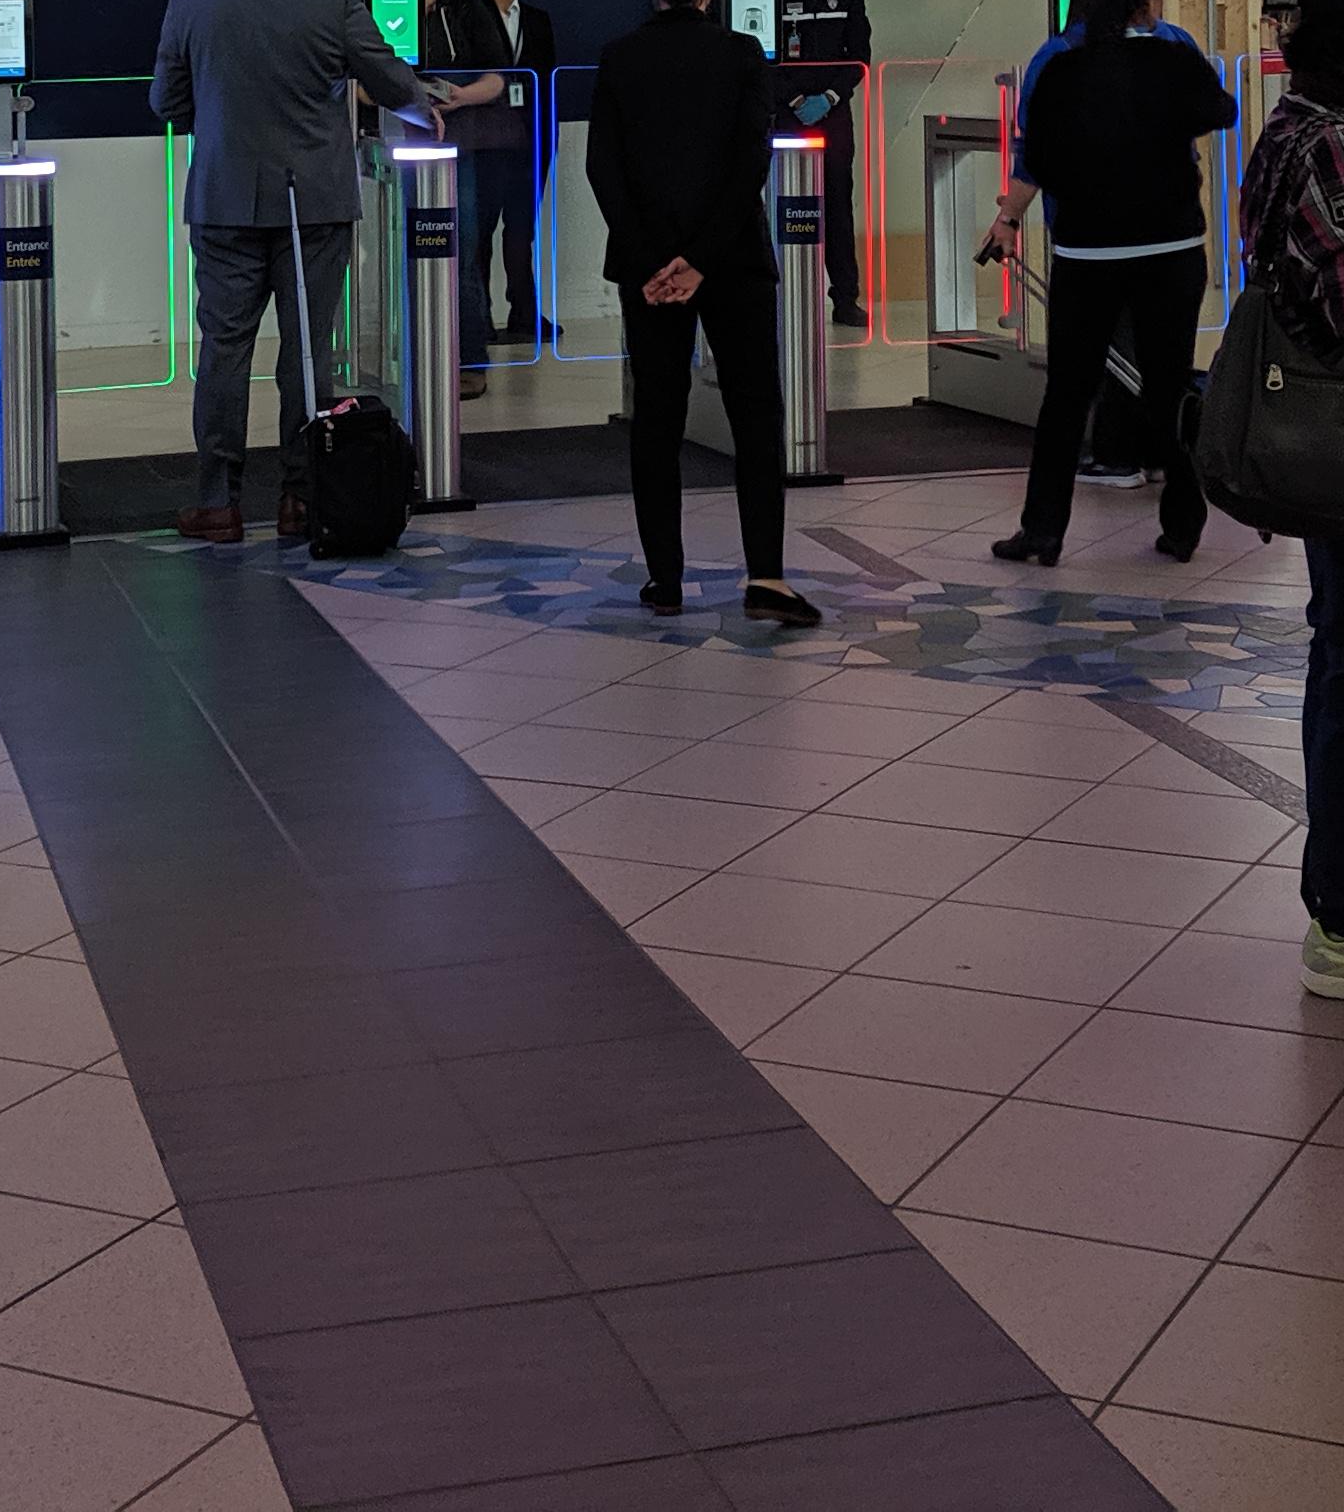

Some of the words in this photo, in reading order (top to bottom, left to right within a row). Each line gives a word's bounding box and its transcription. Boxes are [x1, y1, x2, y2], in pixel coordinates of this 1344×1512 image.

[416, 220, 455, 231] Entrance
[416, 235, 447, 246] Entrée
[6, 241, 49, 252] Entrance
[6, 256, 41, 268] Entrée
